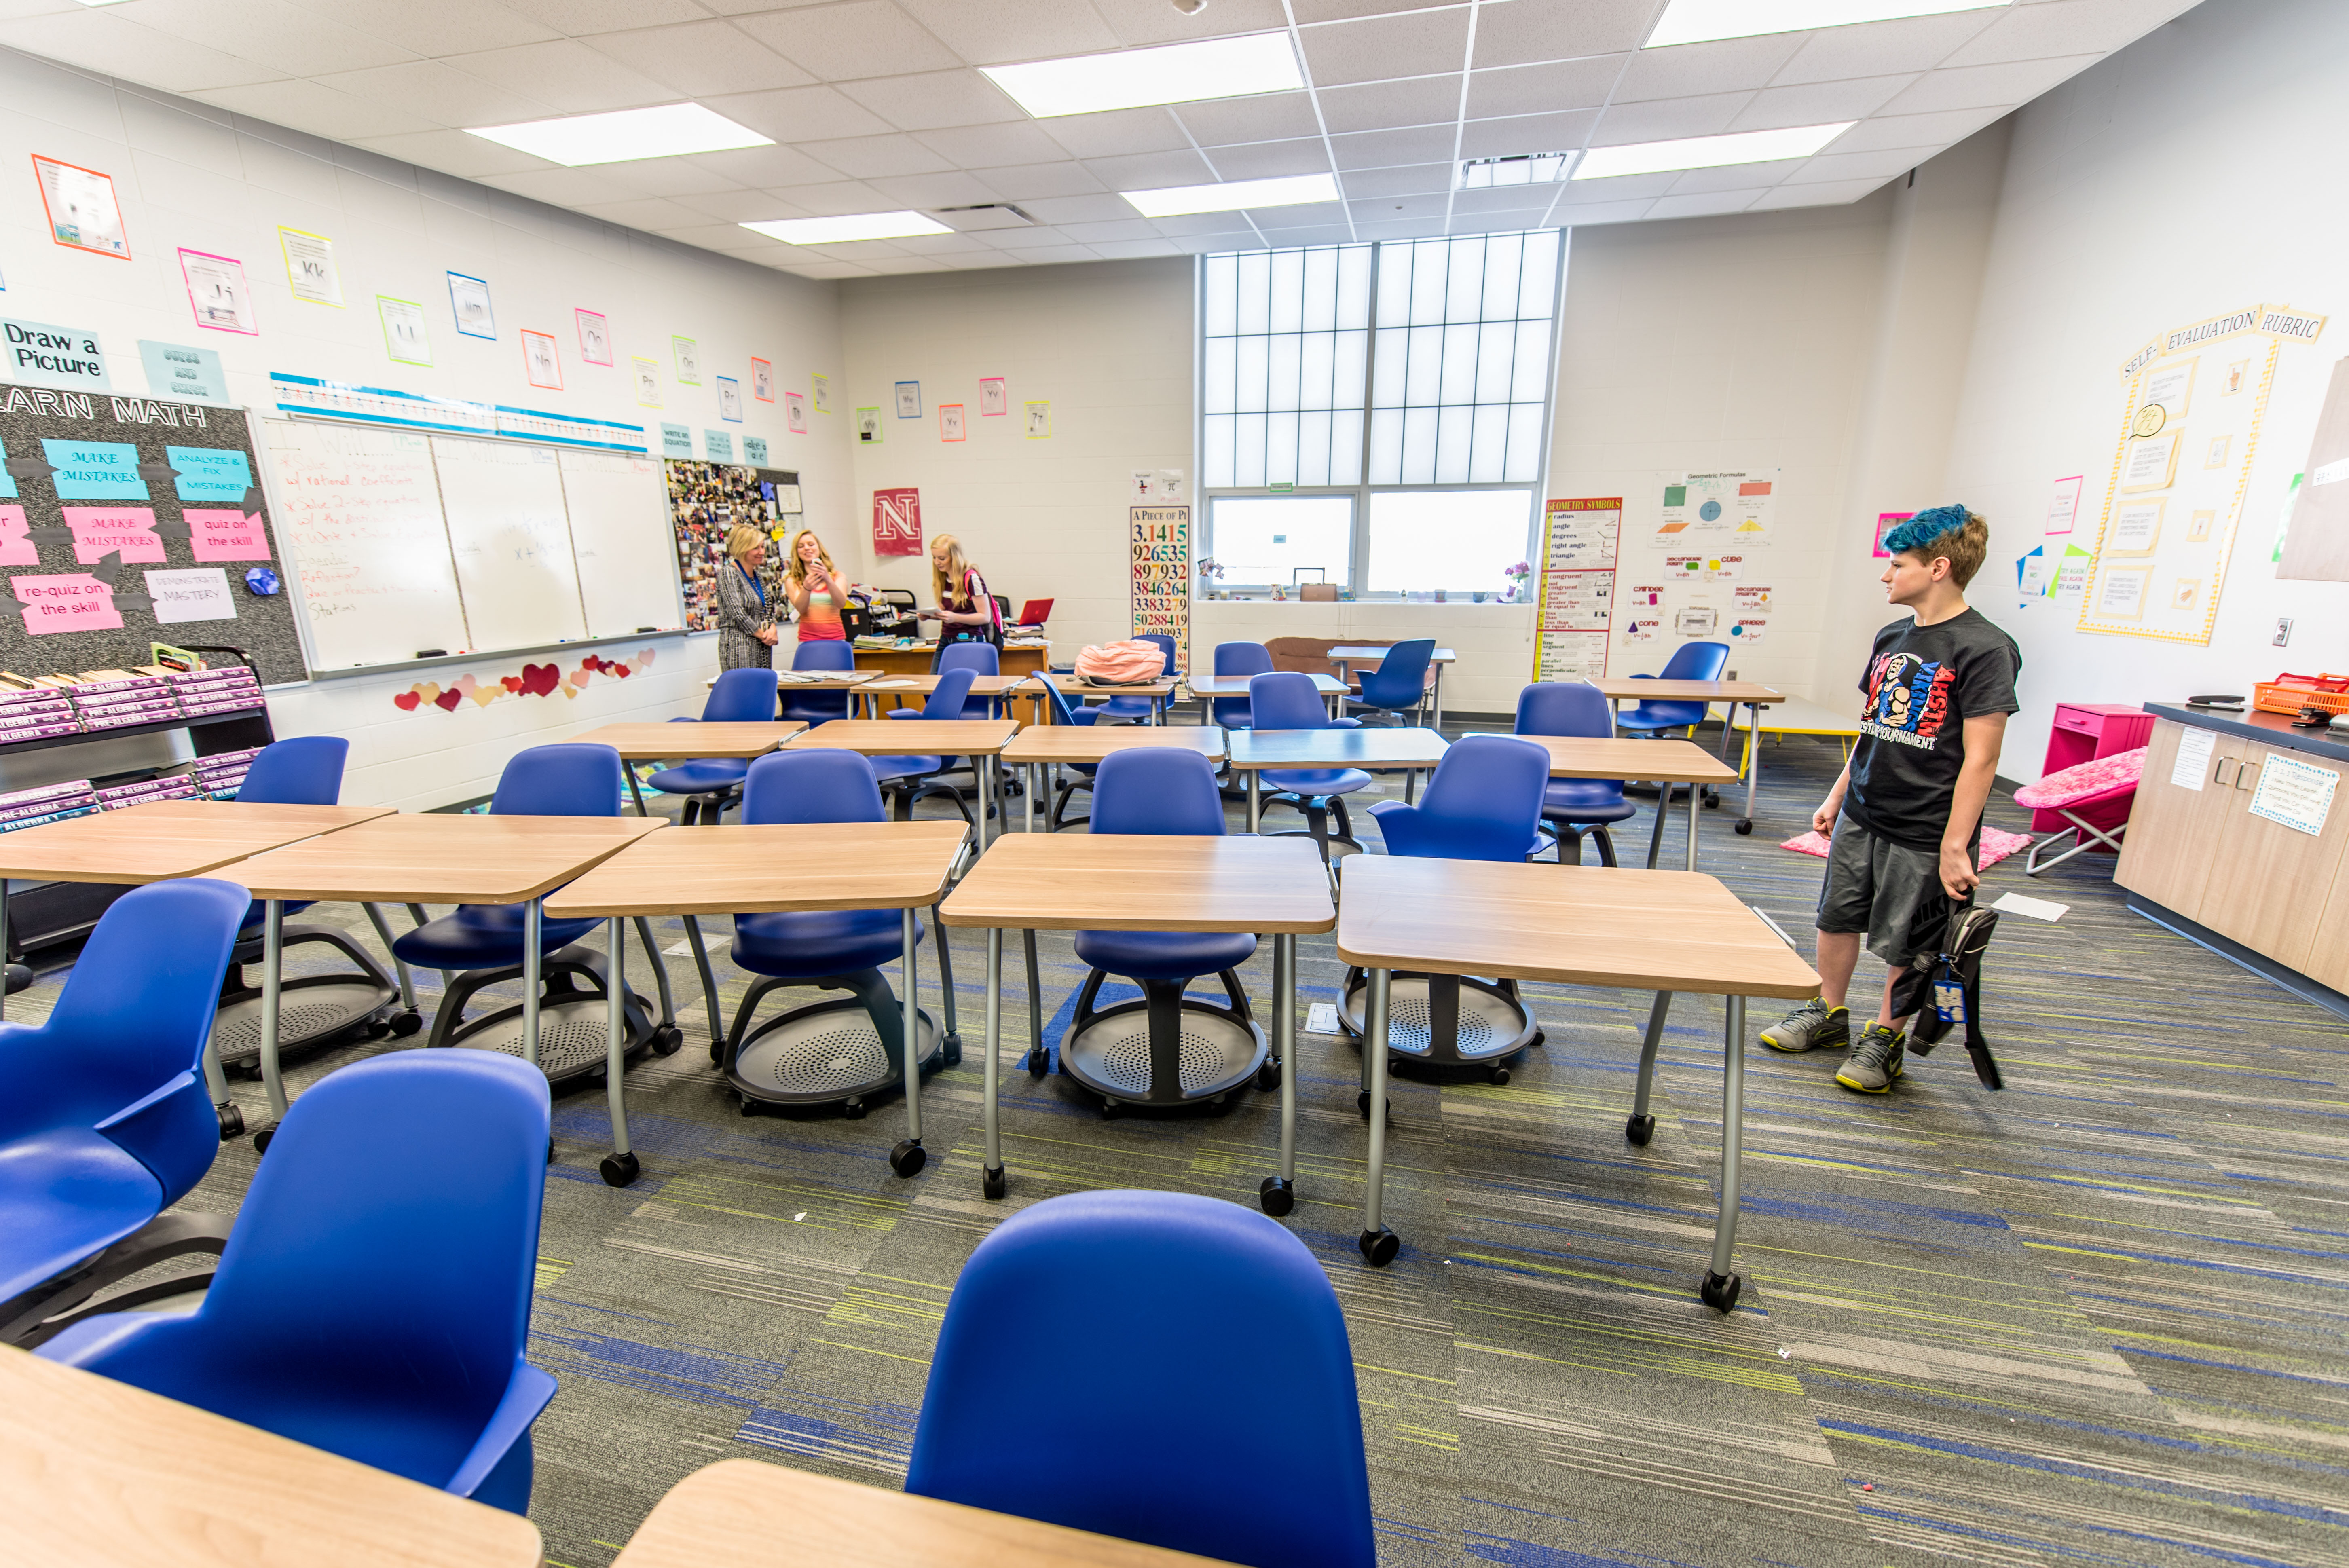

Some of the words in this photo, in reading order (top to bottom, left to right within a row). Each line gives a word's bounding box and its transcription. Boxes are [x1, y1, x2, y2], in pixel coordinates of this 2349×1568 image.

[4, 323, 71, 351] Draw
[83, 340, 99, 355] a
[2125, 346, 2157, 378] SELF-
[2167, 310, 2256, 350] EVALUATION
[2262, 314, 2319, 338] RUBRIC
[16, 348, 100, 376] Picture
[163, 349, 200, 364] GUESS
[174, 367, 197, 380] AND
[171, 382, 209, 397] CHECK
[111, 396, 206, 428] MATH
[664, 430, 681, 438] WRITE
[72, 452, 120, 465] MAKE
[177, 454, 228, 465] ANALYZE
[230, 457, 241, 465] &
[63, 470, 136, 483] MISTAKES
[203, 467, 220, 475] FIX
[187, 481, 243, 492] MISTAKES
[1547, 501, 1585, 511] GEOMETRY
[1587, 499, 1620, 509] SYMBOLS
[875, 494, 920, 540] N
[1133, 511, 1140, 520] A
[91, 518, 137, 528] MAKE
[205, 520, 229, 530] quiz
[233, 521, 247, 529] on
[1133, 524, 1187, 542] 3.1415
[82, 536, 154, 547] MISTAKES
[207, 536, 228, 545] the
[230, 536, 253, 545] skill
[1133, 545, 1187, 562] 926535
[1134, 564, 1187, 580] 897932
[25, 585, 81, 598] re-quiz
[85, 583, 104, 594] on
[1134, 581, 1187, 596] 3846264
[163, 589, 220, 602] MASTERY
[41, 604, 67, 615] the
[72, 601, 101, 613] skill
[1134, 598, 1187, 611] 3383279
[1135, 614, 1187, 626] 50288419
[174, 671, 224, 682] PRE-ALGEBRA
[77, 681, 133, 693] PRE-ALGEBRA
[180, 682, 228, 693] PRE-ALGEBRA
[82, 692, 138, 705] PRE-ALGEBRA
[185, 693, 233, 704] PRE-ALGEBRA
[88, 704, 144, 716] PRE-ALGEBRA
[190, 703, 238, 715] PRE-ALGEBRA
[93, 715, 148, 727] PRE-ALGEBRA
[1876, 726, 1937, 751] TOURNAMENT
[205, 753, 251, 766] PRE-ALGEBRA
[203, 766, 249, 779] PRE-ALGEBRA
[2292, 772, 2324, 786] Response
[106, 782, 160, 799] PRE-ALGEBRA
[111, 793, 165, 809] PRE-ALGEBRA
[4, 816, 51, 831] ALGEBRA
[1911, 894, 1950, 932] NIK
